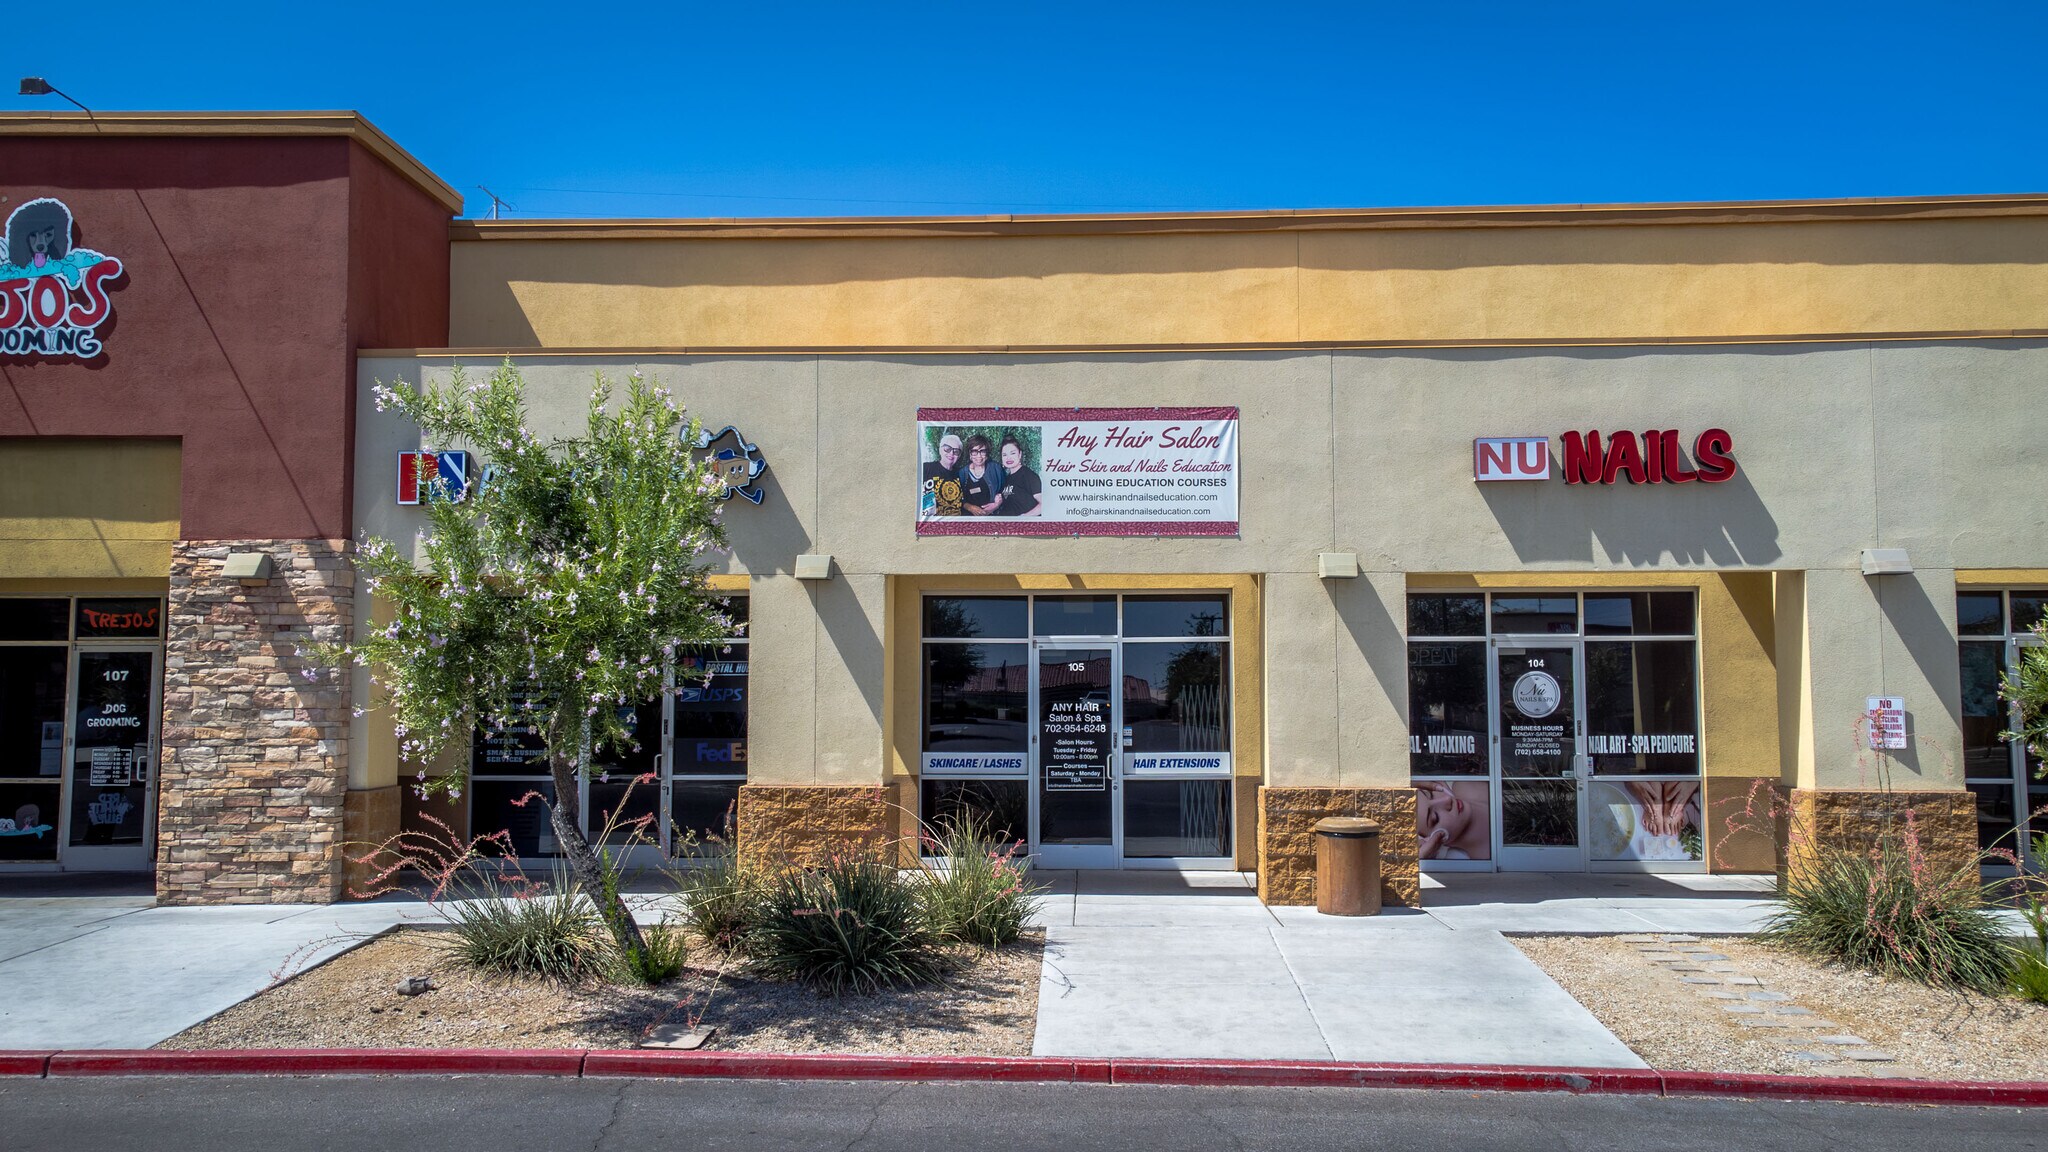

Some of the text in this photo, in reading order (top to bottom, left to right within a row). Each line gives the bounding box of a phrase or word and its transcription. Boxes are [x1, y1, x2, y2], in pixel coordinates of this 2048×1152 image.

[1057, 425, 1221, 455] Any Hair Salon
[1479, 428, 1737, 485] NU NAILS
[1045, 458, 1232, 473] Hair Skin and Nails Education
[1049, 477, 1227, 488] CONTINUING EDUCATION COURSES
[1058, 492, 1218, 502] www.hairskinandnailseducation.com
[1065, 507, 1211, 516] info@hairskinandnailseducation.com
[83, 608, 158, 629] TREJOS
[1067, 662, 1085, 672] 105
[1527, 658, 1545, 668] 104
[102, 670, 130, 682] 107
[701, 688, 744, 701] USPS
[1520, 683, 1547, 696] Nu
[101, 704, 127, 715] DOG
[1051, 702, 1100, 712] ANY HAIR
[1879, 700, 1892, 709] NO
[86, 717, 141, 728] GROOMING
[1049, 713, 1102, 723] Salon & Spa
[1045, 724, 1107, 733] 702-954-6248
[1428, 735, 1476, 754] WAXING
[1588, 734, 1696, 754] NAIL ART SPA PEDICURE
[696, 742, 747, 762] FedE
[1133, 758, 1221, 769] HAIR EXTENSIONS
